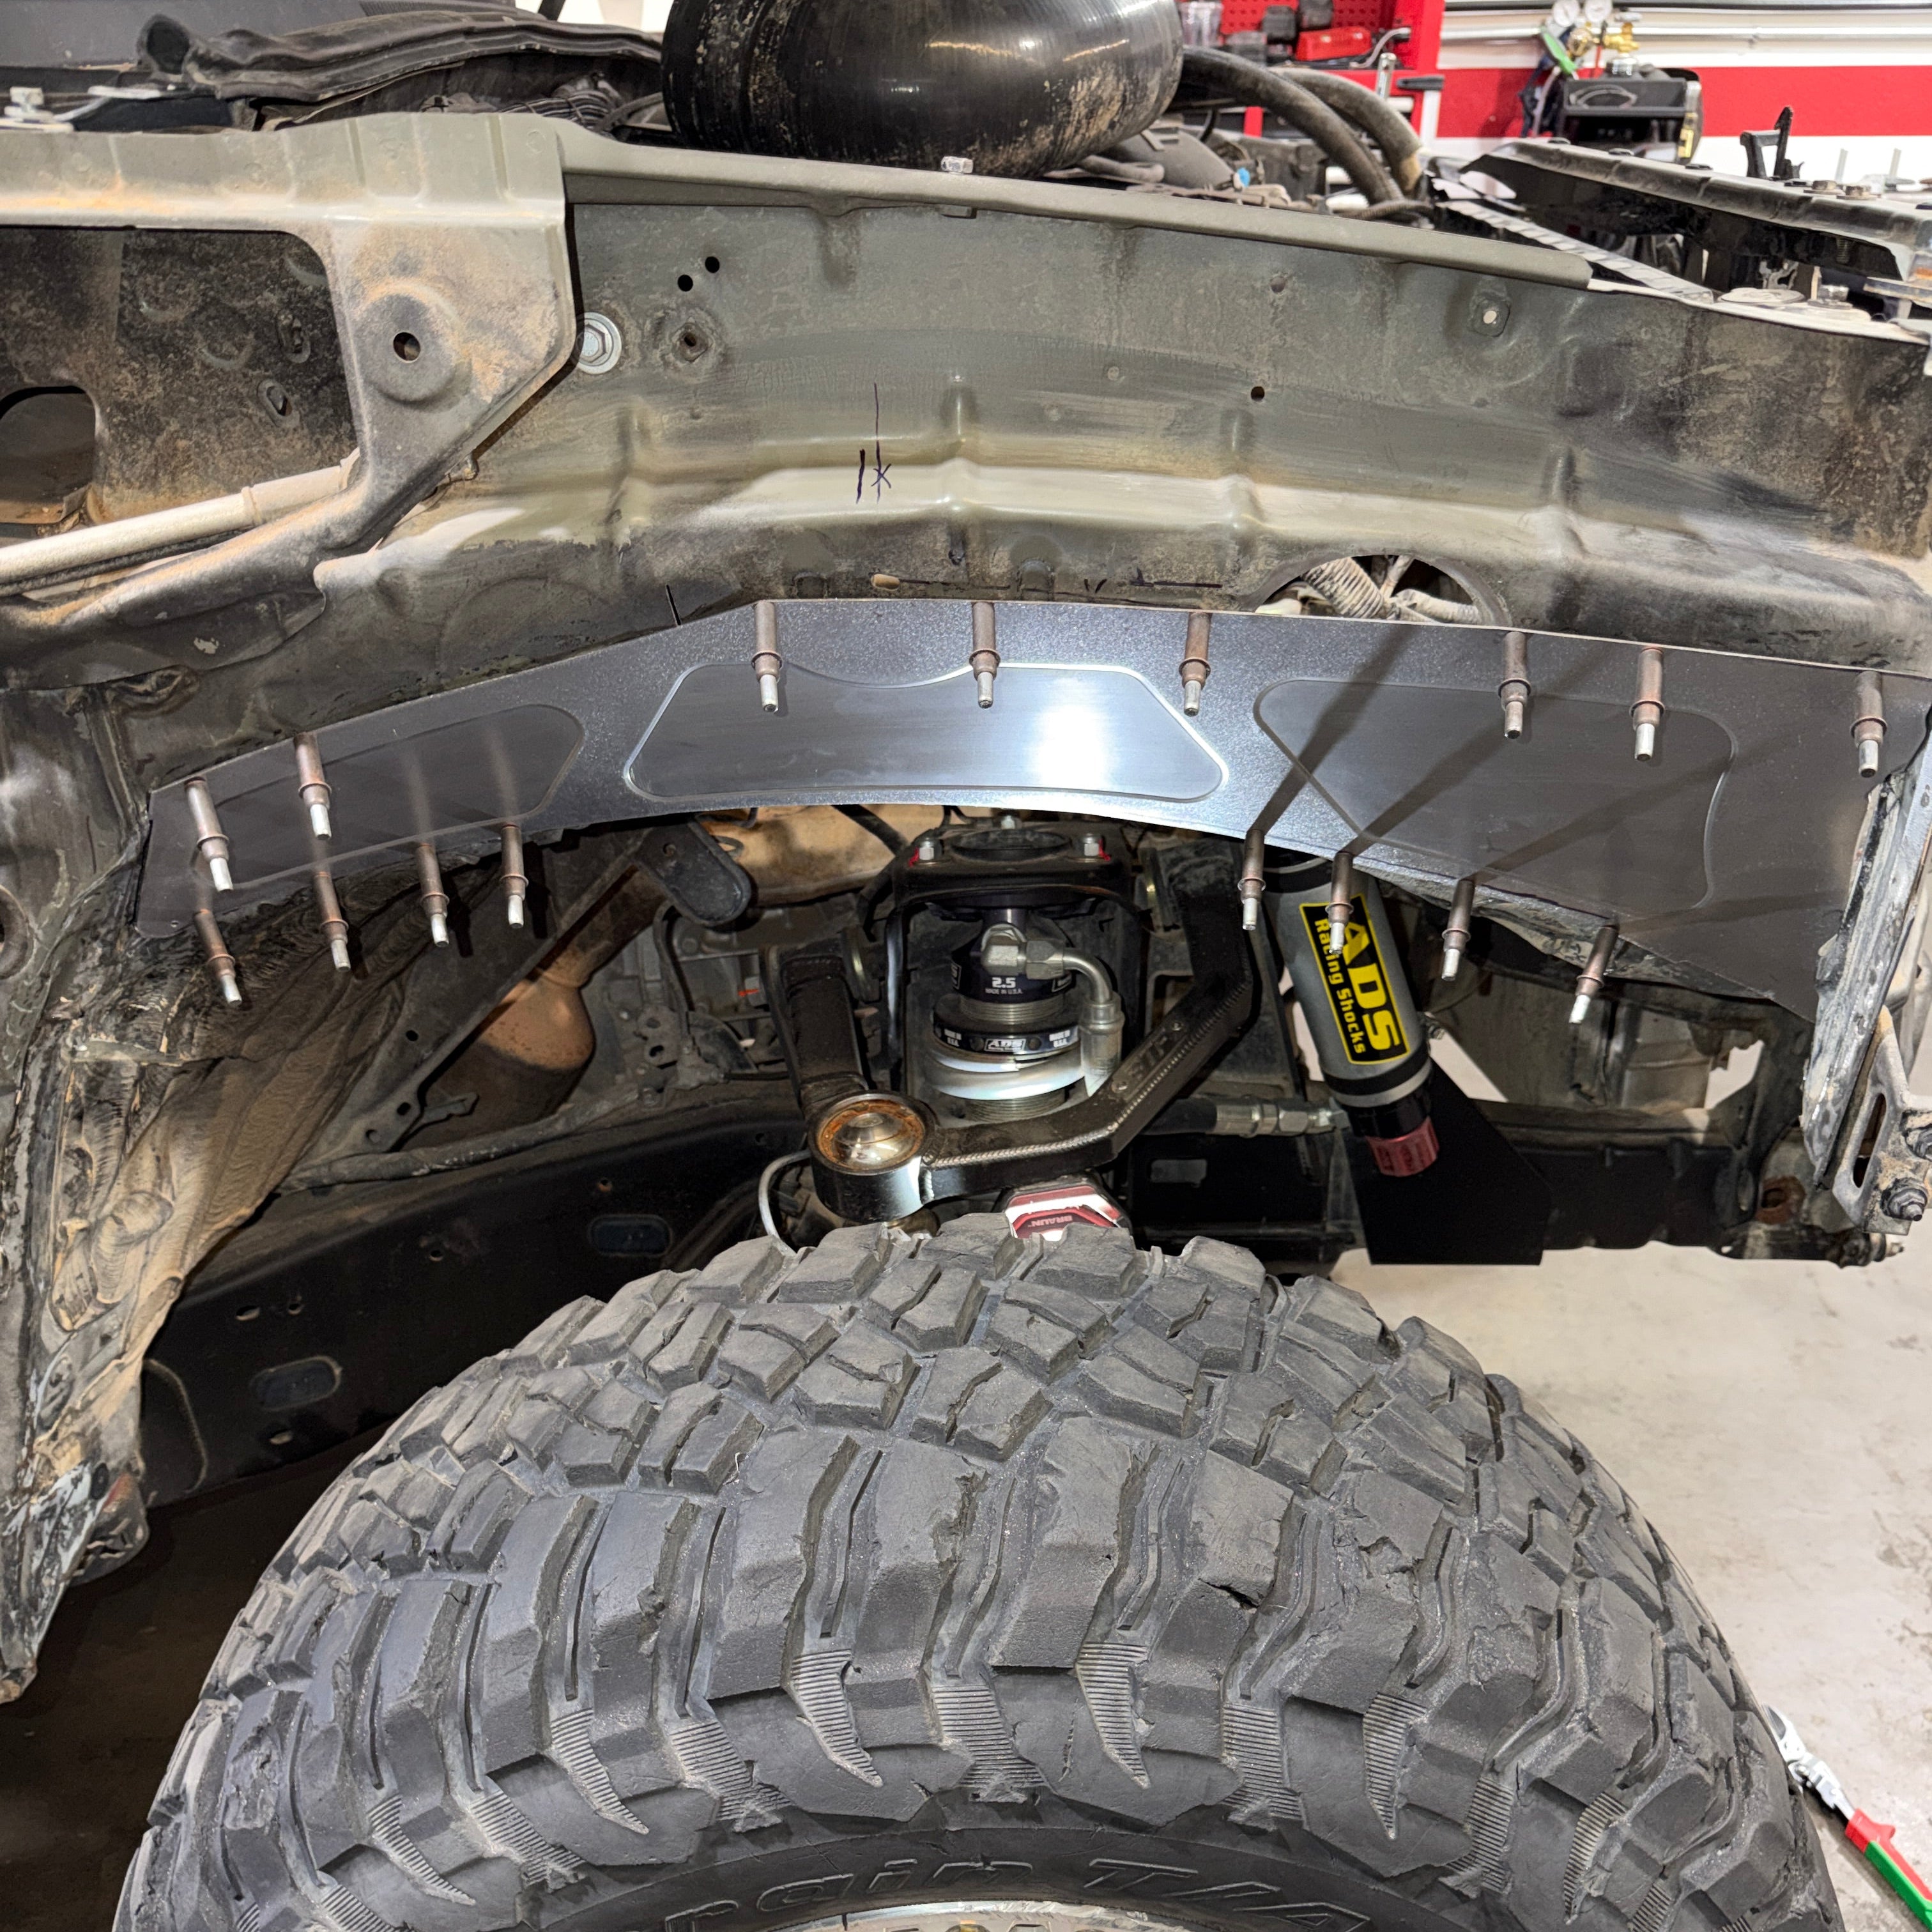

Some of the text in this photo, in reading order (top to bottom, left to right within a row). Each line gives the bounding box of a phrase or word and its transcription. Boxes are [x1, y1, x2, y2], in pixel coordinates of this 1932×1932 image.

[992, 977, 1016, 988] 2.5
[1342, 922, 1400, 1050] ADS
[1336, 989, 1366, 1054] Shocks
[988, 1039, 1022, 1048] ADS
[1031, 1215, 1073, 1226] BRAUN
[625, 1857, 1034, 1932] rain
